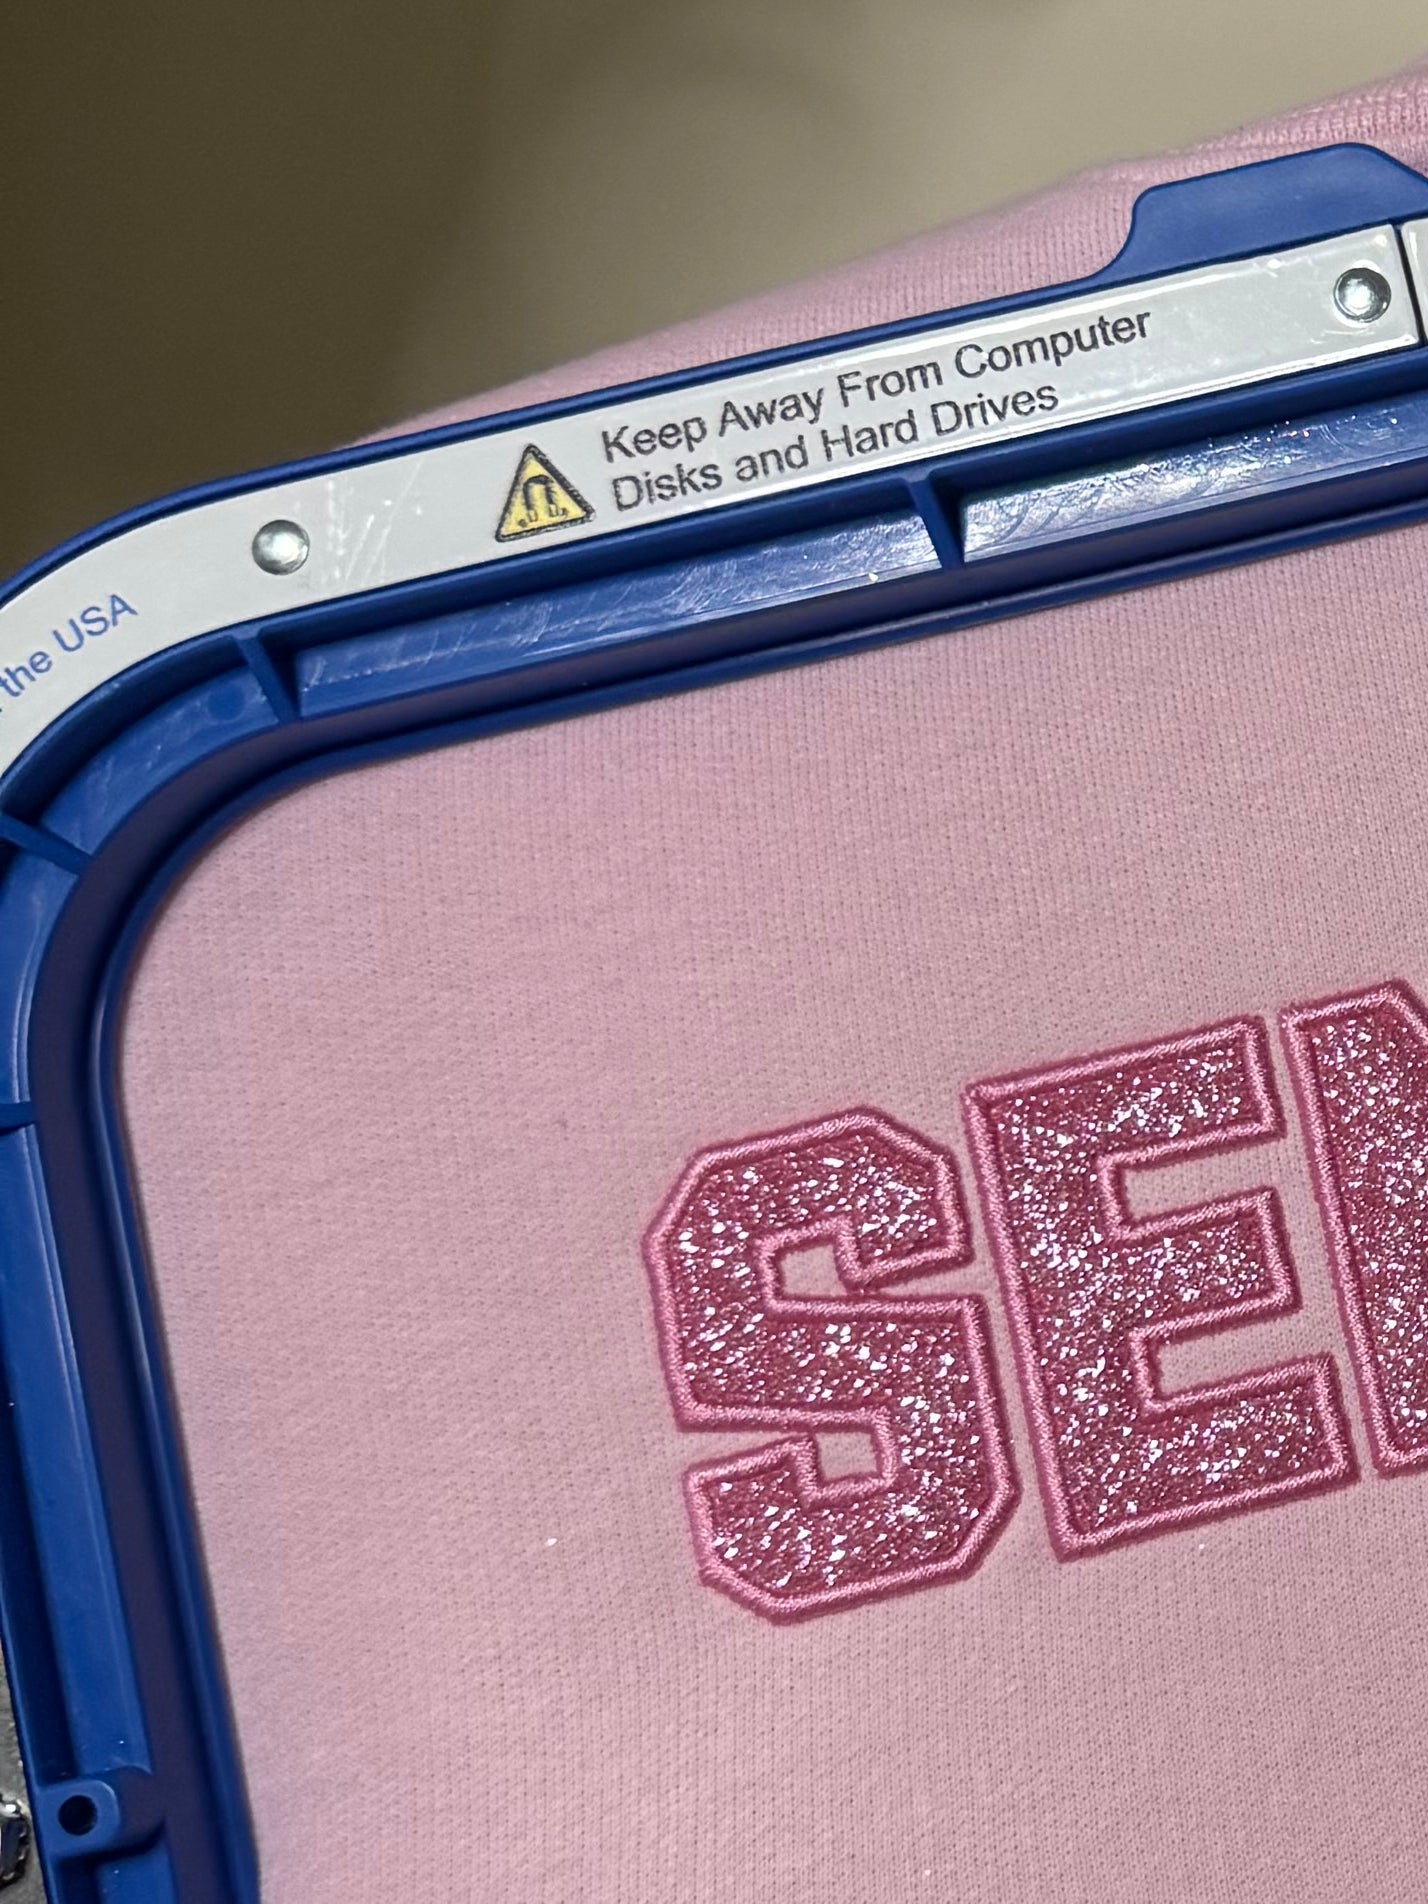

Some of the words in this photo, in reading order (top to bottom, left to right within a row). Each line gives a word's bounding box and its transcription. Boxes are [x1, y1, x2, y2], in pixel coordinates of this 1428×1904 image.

[601, 413, 707, 463] Keep
[718, 385, 824, 437] Away
[837, 360, 943, 406] From
[955, 309, 1151, 380] Computer
[611, 463, 723, 511] Disks
[735, 439, 808, 482] and
[823, 409, 919, 462] Hard
[930, 382, 1058, 435] Drives
[0, 651, 52, 697] the
[53, 594, 138, 652] USA
